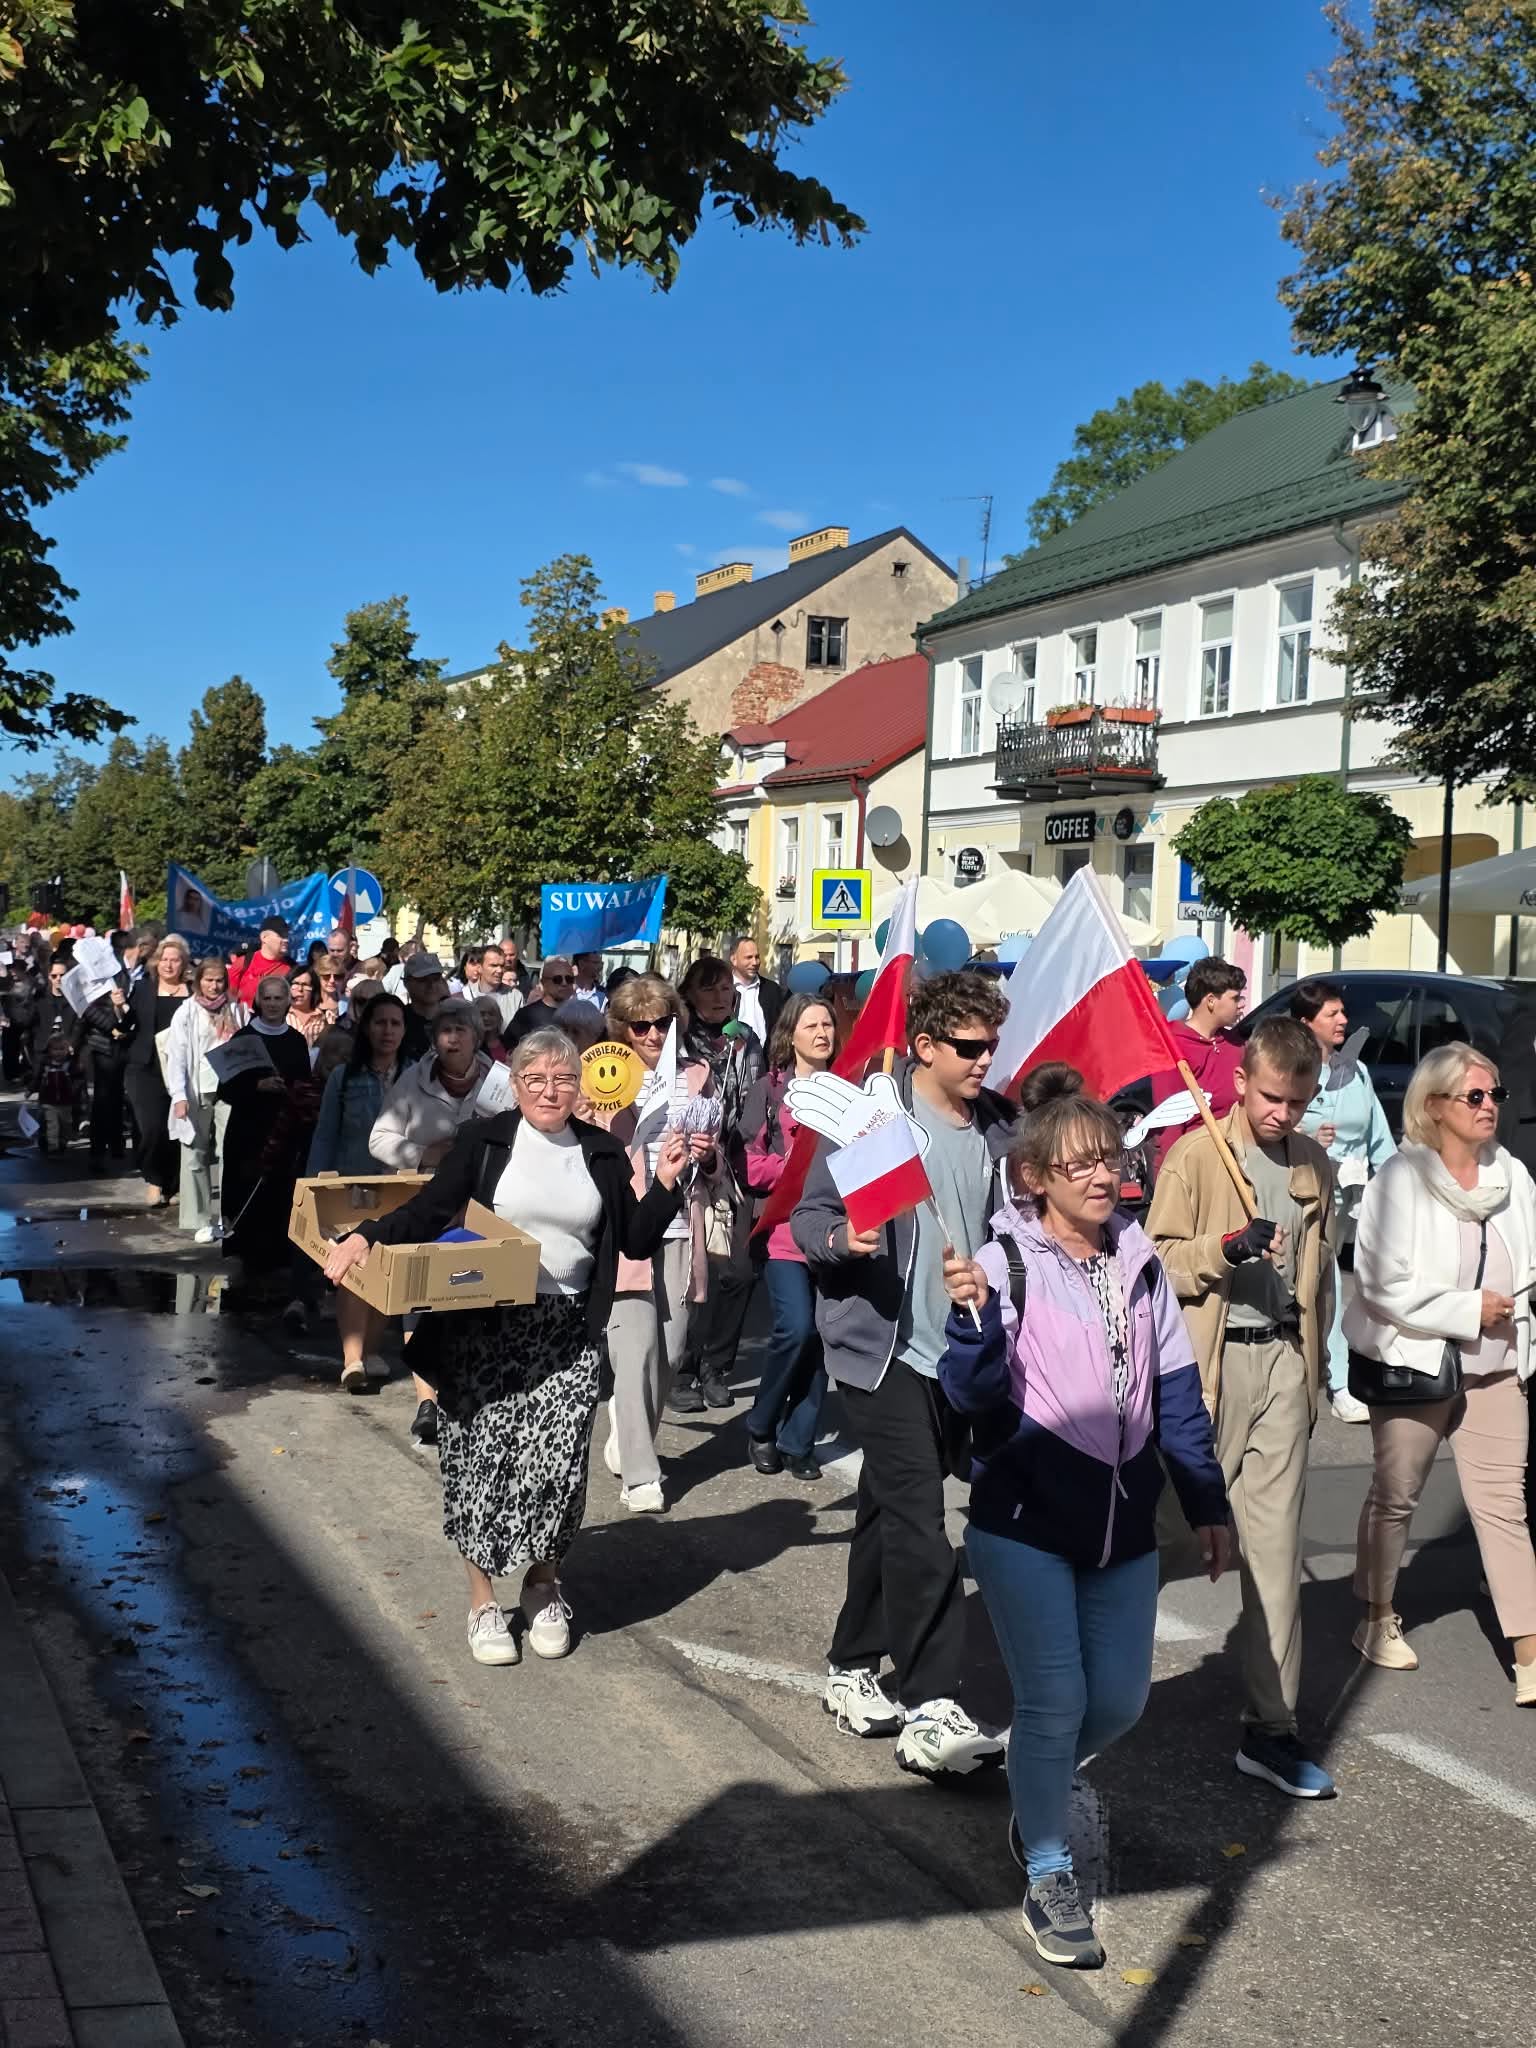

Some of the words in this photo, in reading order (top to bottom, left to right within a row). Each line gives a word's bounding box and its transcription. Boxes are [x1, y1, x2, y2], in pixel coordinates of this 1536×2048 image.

[1045, 816, 1090, 841] COFFEE
[583, 1045, 632, 1064] WYBIERAM
[596, 1099, 623, 1112] ŻYCIE
[865, 1108, 885, 1129] MARSZ
